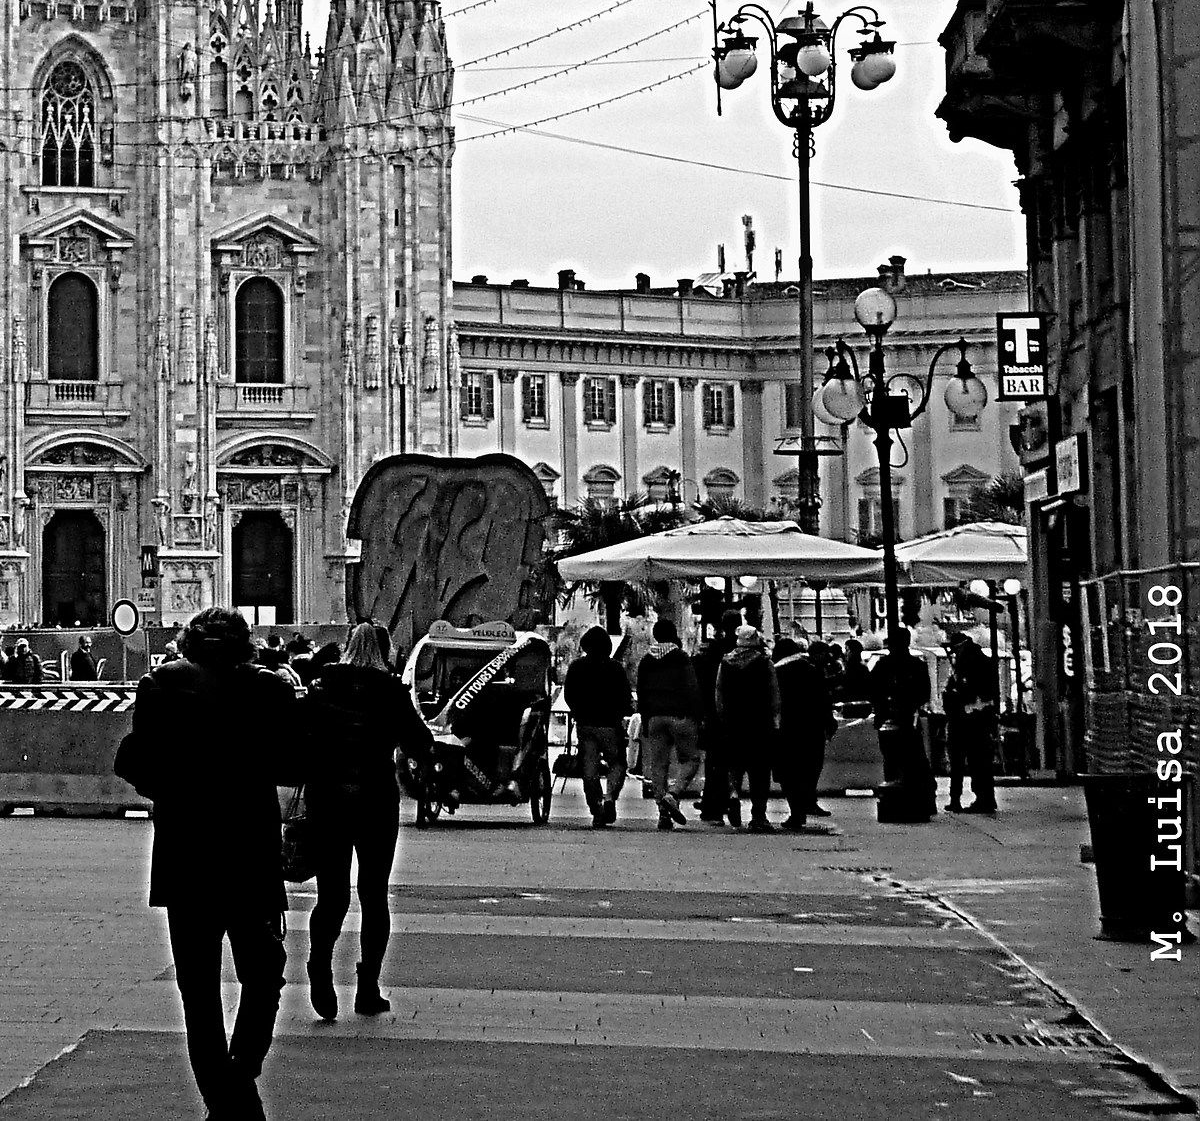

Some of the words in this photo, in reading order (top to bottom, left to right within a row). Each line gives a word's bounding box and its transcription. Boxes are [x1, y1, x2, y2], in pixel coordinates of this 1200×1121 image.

[1003, 318, 1040, 363] T
[1003, 365, 1043, 374] Tabacchi
[1007, 380, 1041, 393] BAR
[455, 690, 474, 709] CITY
[468, 670, 492, 694] TOURS
